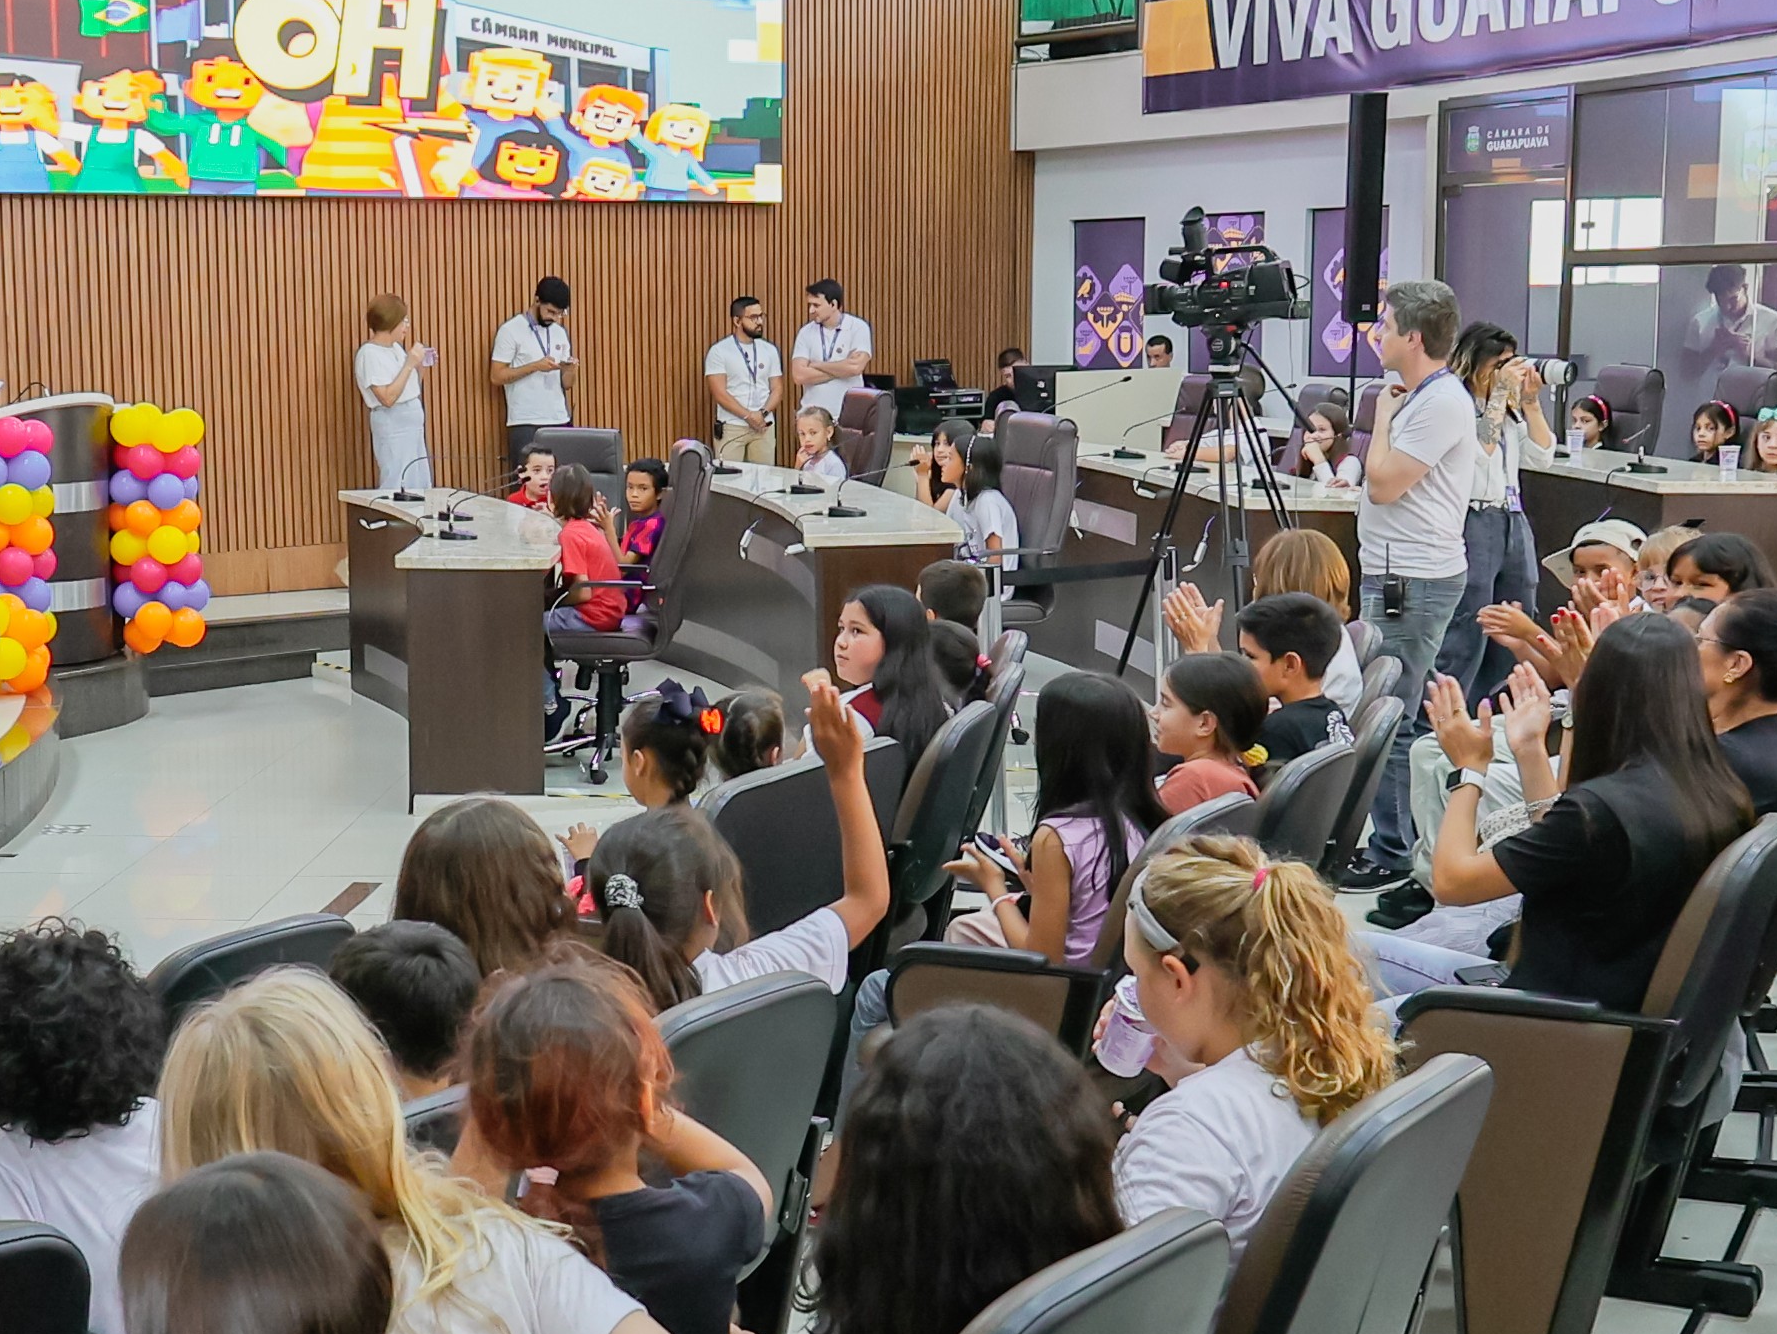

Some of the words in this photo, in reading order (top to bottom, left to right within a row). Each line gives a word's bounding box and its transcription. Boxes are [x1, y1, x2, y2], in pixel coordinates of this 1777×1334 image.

[471, 17, 539, 44] CÂMARA
[547, 32, 618, 59] MUNICIPAL
[1487, 127, 1531, 139] CÂMARA
[1537, 125, 1550, 134] DE
[1486, 136, 1550, 152] GUARAPUAVA
